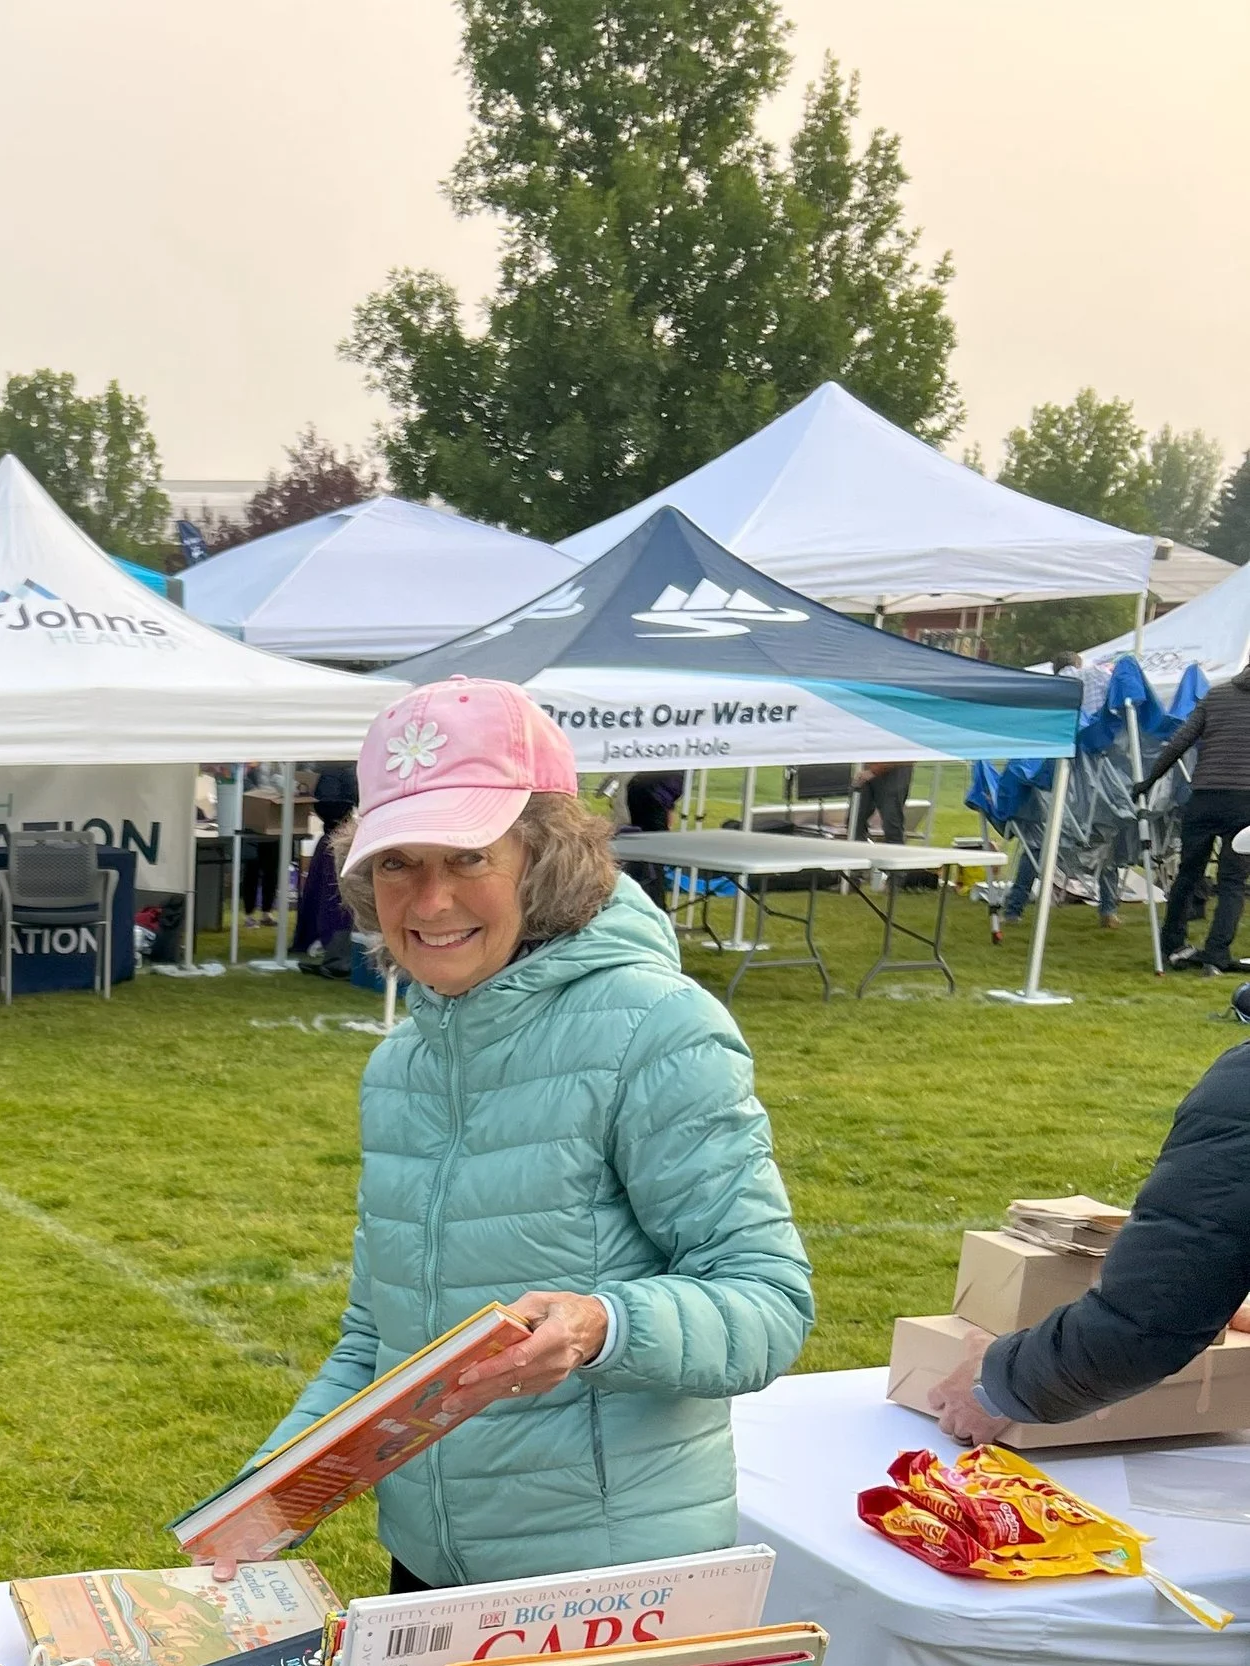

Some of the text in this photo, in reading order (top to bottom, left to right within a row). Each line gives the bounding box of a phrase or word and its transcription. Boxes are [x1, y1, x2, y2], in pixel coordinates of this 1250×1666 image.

[47, 630, 178, 651] HEALTH
[652, 704, 705, 727] Our
[712, 701, 798, 725] Water
[602, 737, 730, 764] Jackson Hole
[239, 1566, 266, 1600] Garden
[269, 1579, 299, 1612] Child's
[367, 1607, 426, 1625] CHITTY
[430, 1599, 488, 1616] CHITTY
[492, 1595, 534, 1608] BANG
[538, 1588, 580, 1602] BANG
[598, 1573, 682, 1593] LIMOUSINE
[700, 1568, 730, 1580] THE
[733, 1561, 771, 1575] SLUG
[481, 1612, 504, 1629] DK
[514, 1587, 674, 1624] BIG BOOK OF
